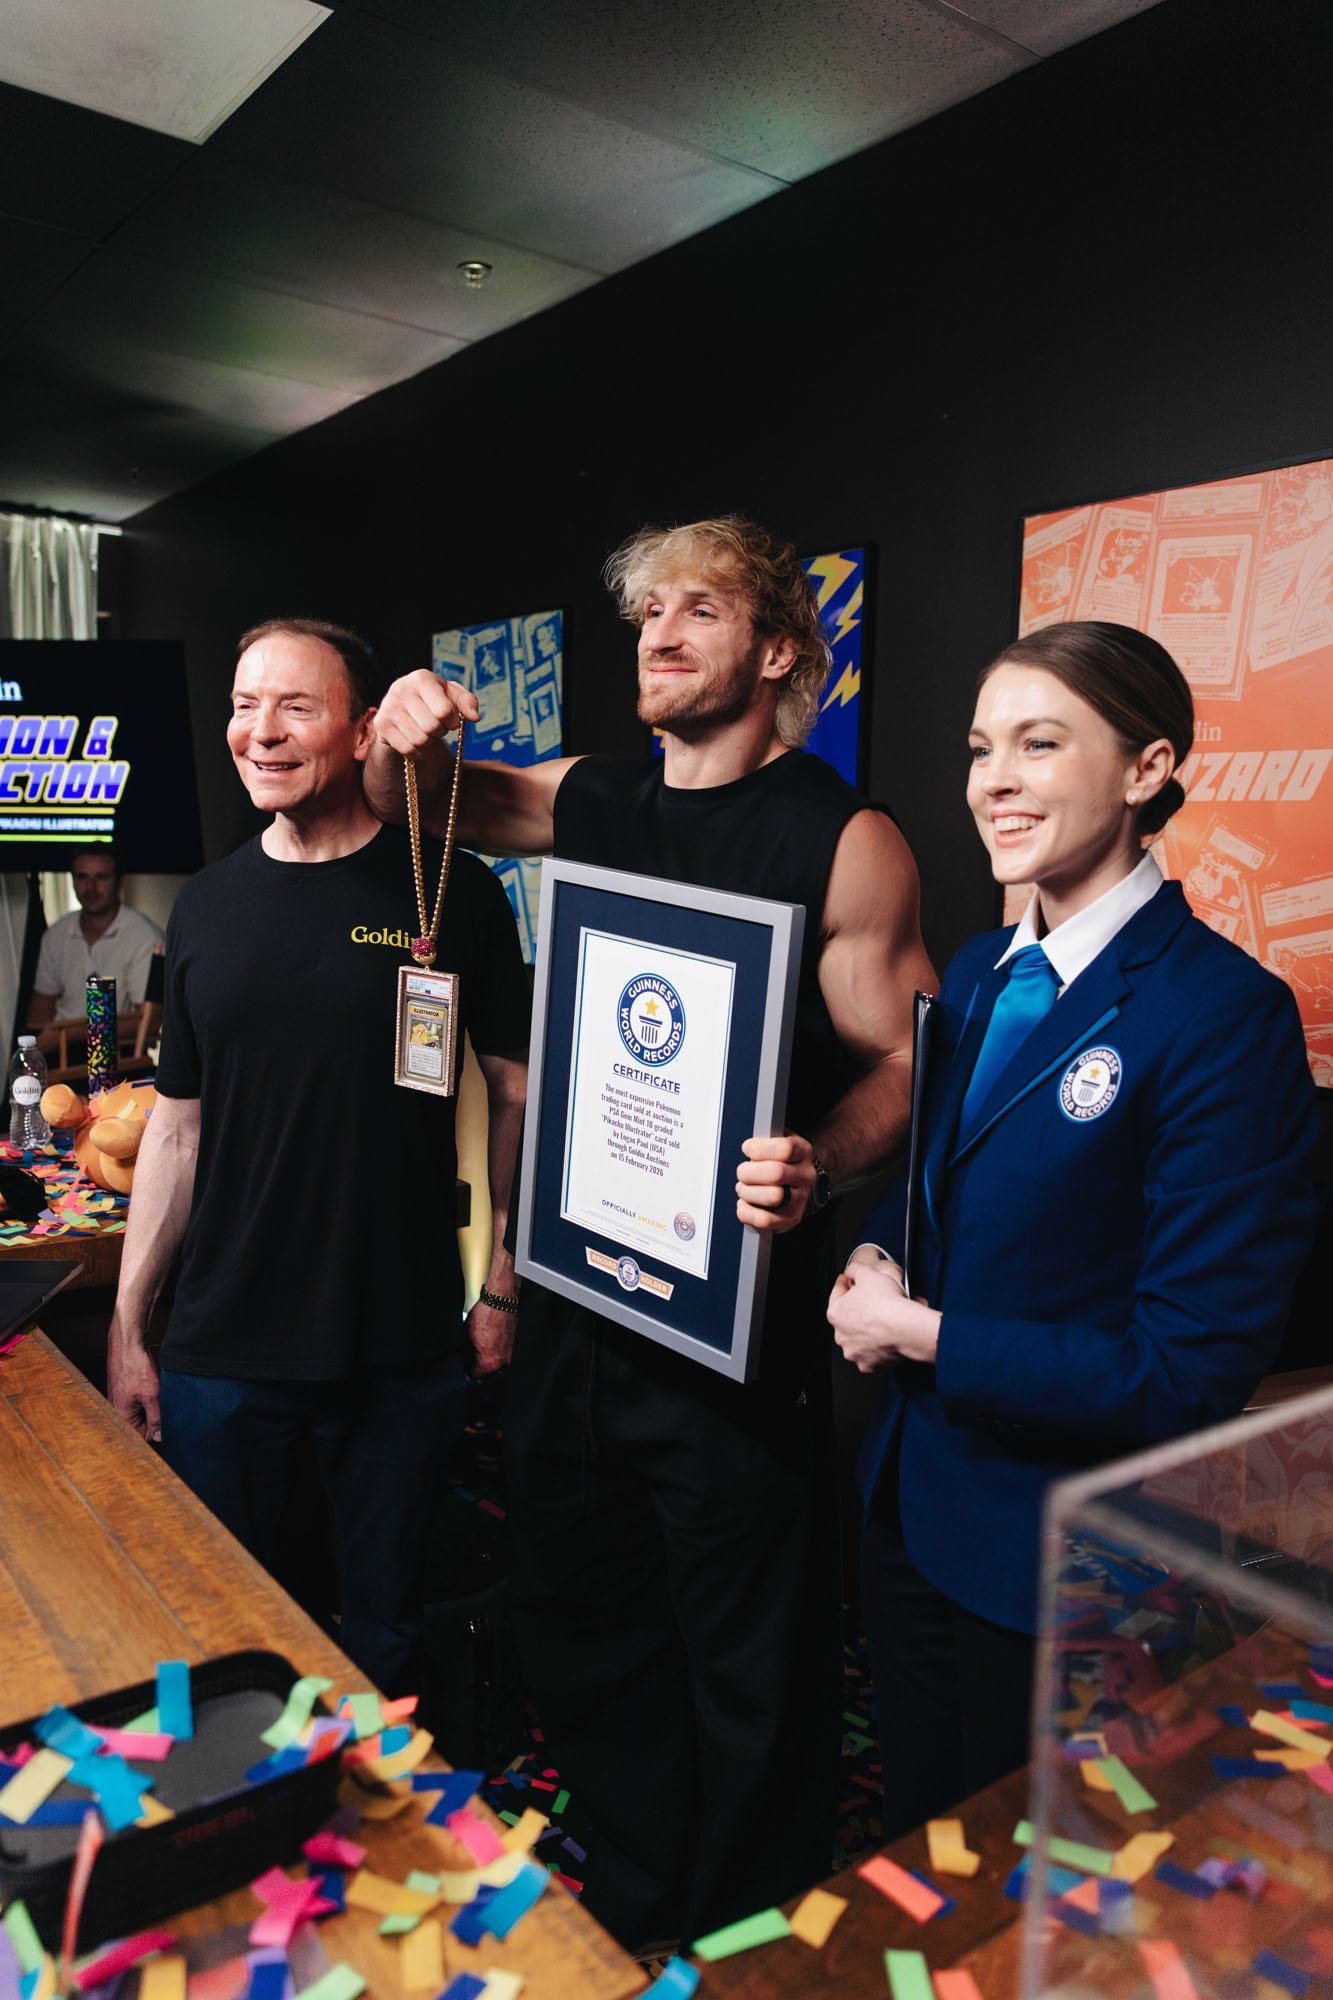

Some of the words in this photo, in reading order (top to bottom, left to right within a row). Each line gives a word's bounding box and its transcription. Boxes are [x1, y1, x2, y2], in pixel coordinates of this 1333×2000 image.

[82, 715, 118, 760] &
[1173, 749, 1333, 801] IZARD
[350, 926, 416, 949] Goldi
[628, 979, 678, 1010] GUINNESS
[413, 1008, 440, 1017] ILLUSTRATOR
[621, 1008, 641, 1054] WORLD
[643, 1021, 682, 1062] RECORDS
[1079, 1050, 1118, 1075] GUINNESS
[613, 1063, 681, 1093] CERTIFICATE
[601, 1093, 620, 1107] trading
[620, 1100, 632, 1110] card
[633, 1105, 644, 1114] sold
[652, 1113, 673, 1124] auction
[605, 1083, 614, 1093] The
[615, 1088, 628, 1098] most
[629, 1092, 655, 1107] expensive
[1063, 1072, 1075, 1111] WORLD
[1074, 1084, 1116, 1117] RECORDS
[609, 1106, 620, 1117] PSA
[621, 1111, 632, 1121] Gem
[634, 1115, 645, 1126] Mint
[646, 1119, 653, 1129] 10
[654, 1124, 673, 1136] graded
[607, 1138, 627, 1152] through
[628, 1146, 645, 1158] Goldin
[646, 1153, 669, 1168] Auctions
[613, 1130, 619, 1139] by
[620, 1132, 635, 1144] Logan
[636, 1138, 648, 1149] Paul
[649, 1143, 665, 1156] (USA)
[654, 1135, 667, 1145] card
[668, 1140, 680, 1149] sold
[611, 1151, 617, 1159] on
[618, 1153, 625, 1161] 15
[625, 1156, 649, 1172] February
[649, 1165, 663, 1177] 2026
[601, 1199, 636, 1219] OFFICIALLY
[637, 1214, 668, 1232] AMAZING
[591, 1254, 617, 1269] RECORD
[641, 1275, 667, 1292] HOLDER
